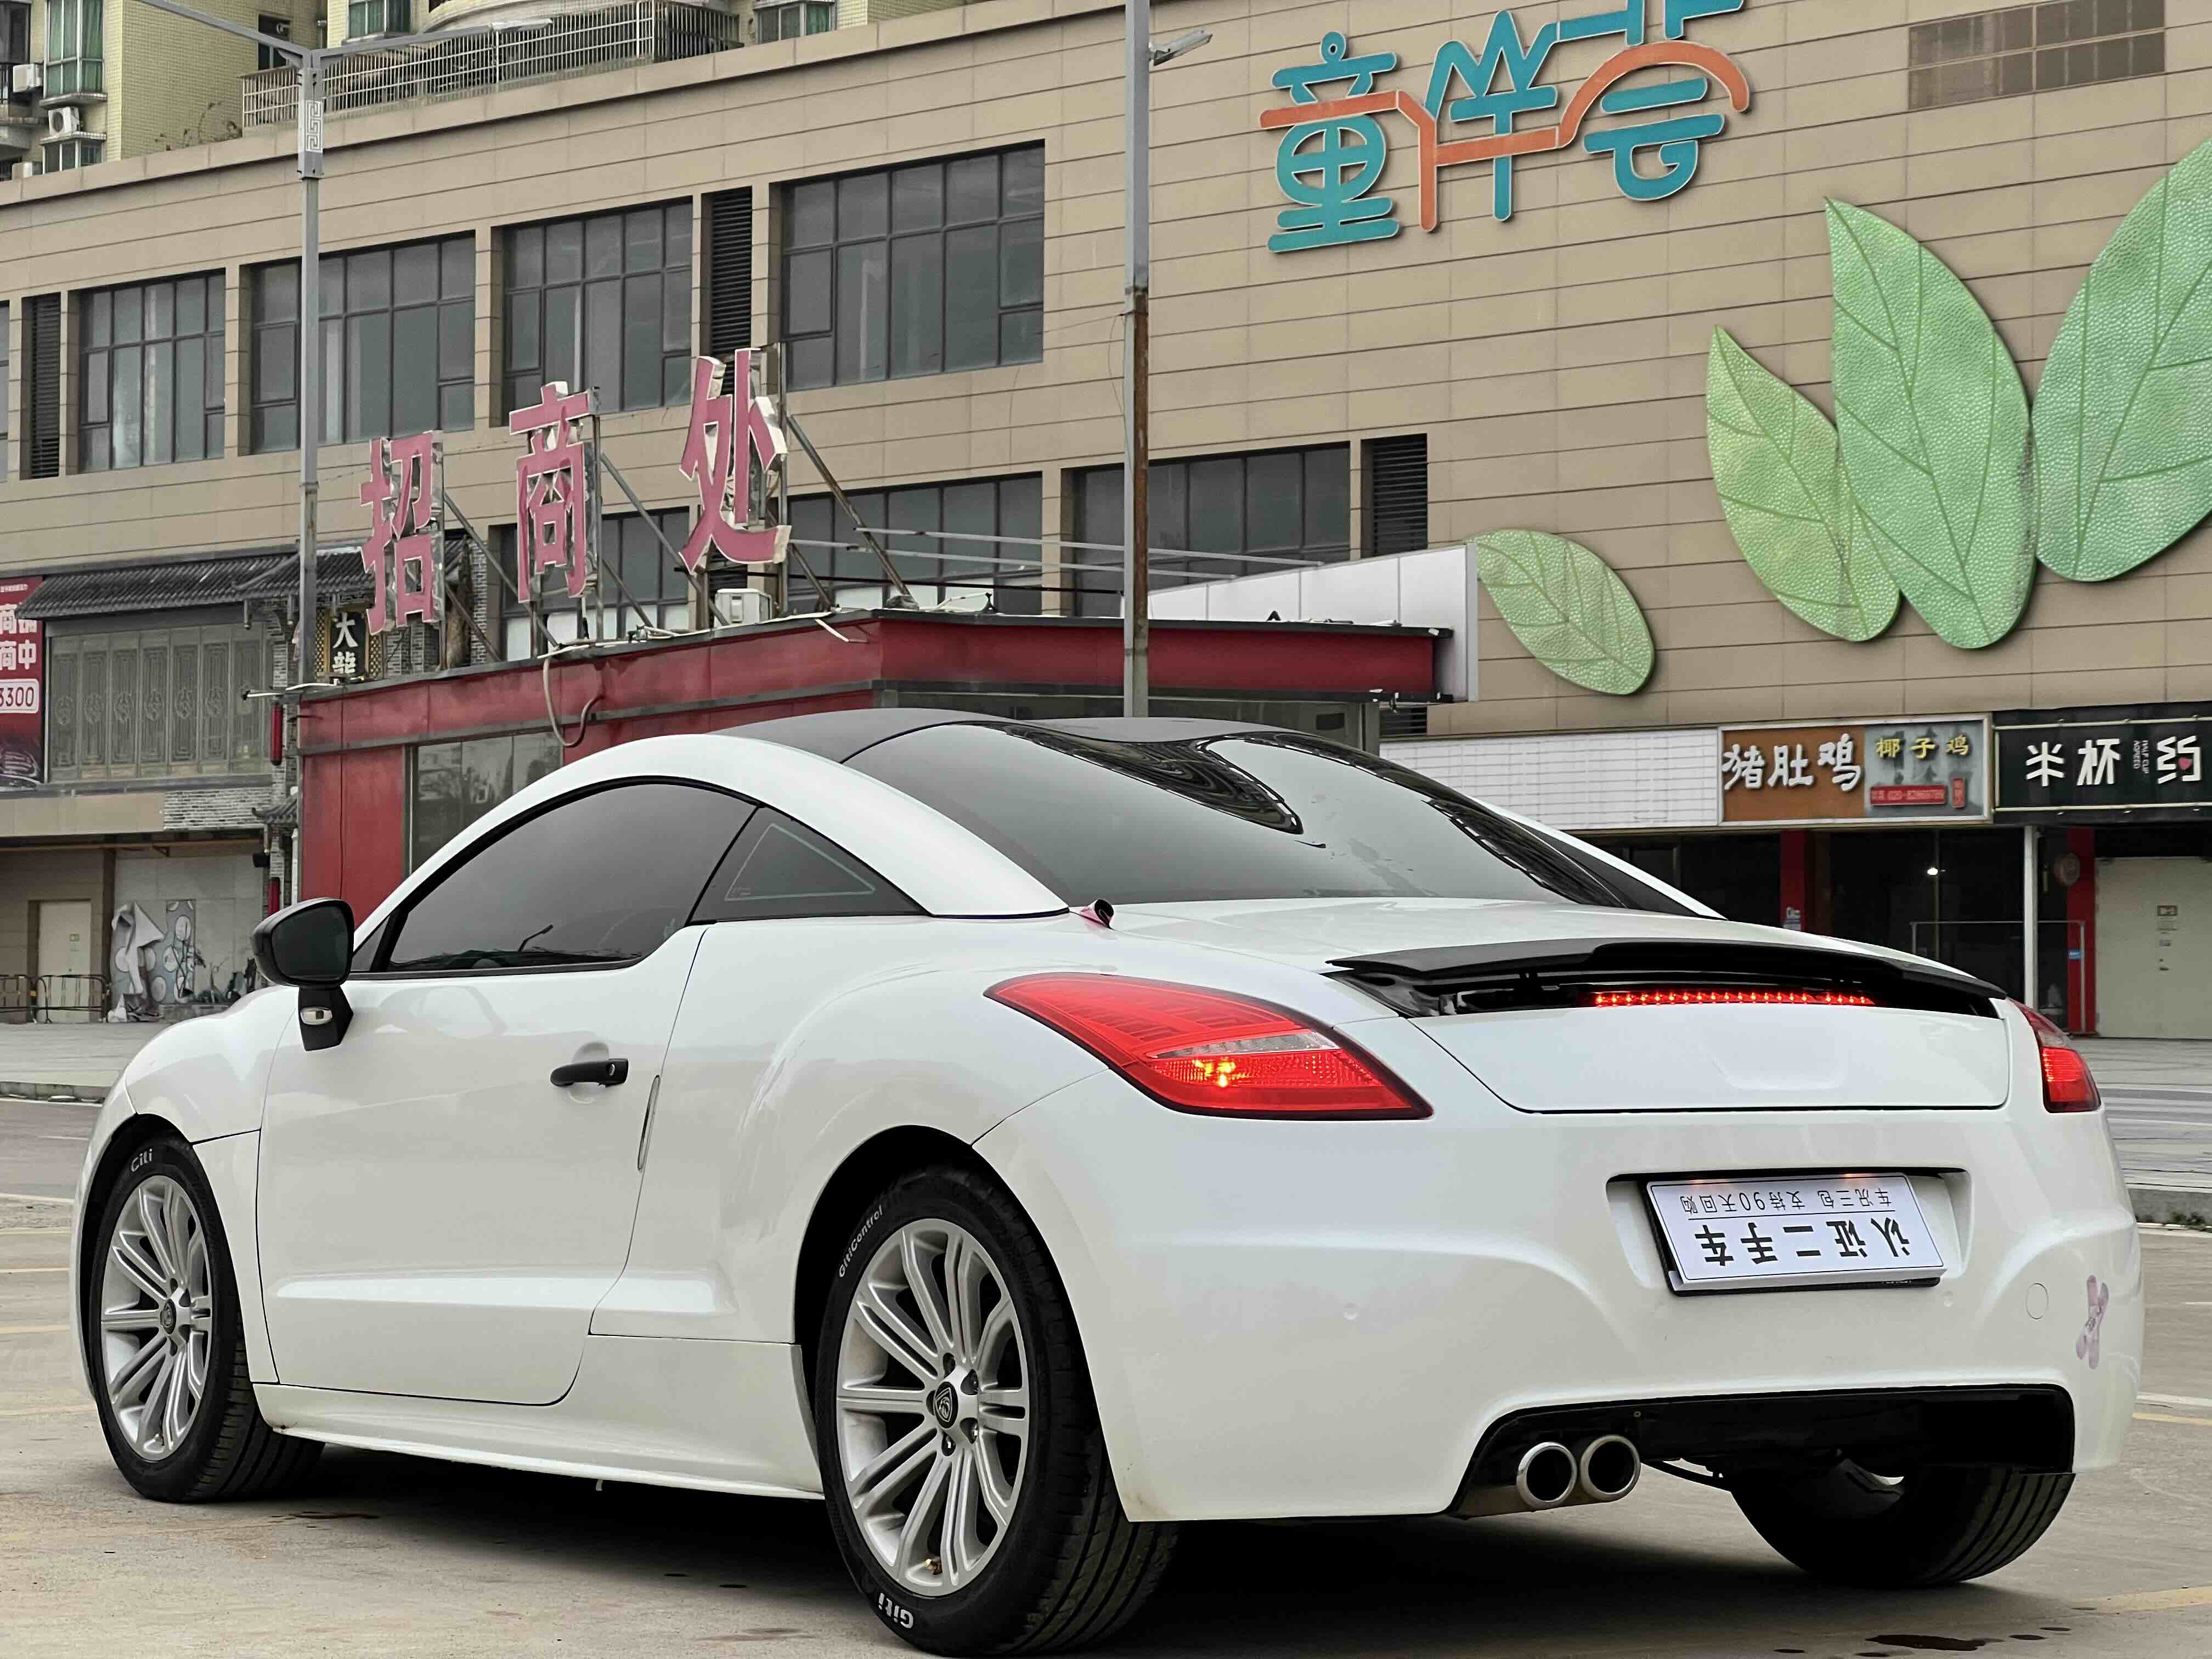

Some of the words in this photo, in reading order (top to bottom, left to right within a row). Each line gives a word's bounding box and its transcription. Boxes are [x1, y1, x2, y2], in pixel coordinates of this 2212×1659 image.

[360, 348, 791, 635] 招商处
[1721, 733, 1861, 792] 猪肚鸡
[1876, 733, 1970, 759] 椰子鸡
[2025, 736, 2202, 787] 半杯约
[1680, 1190, 1805, 1214] 支持90天回购
[1818, 1188, 1892, 1208] 车况三包
[1695, 1217, 1910, 1266] 认证二手车
[878, 1593, 913, 1628] Giti
